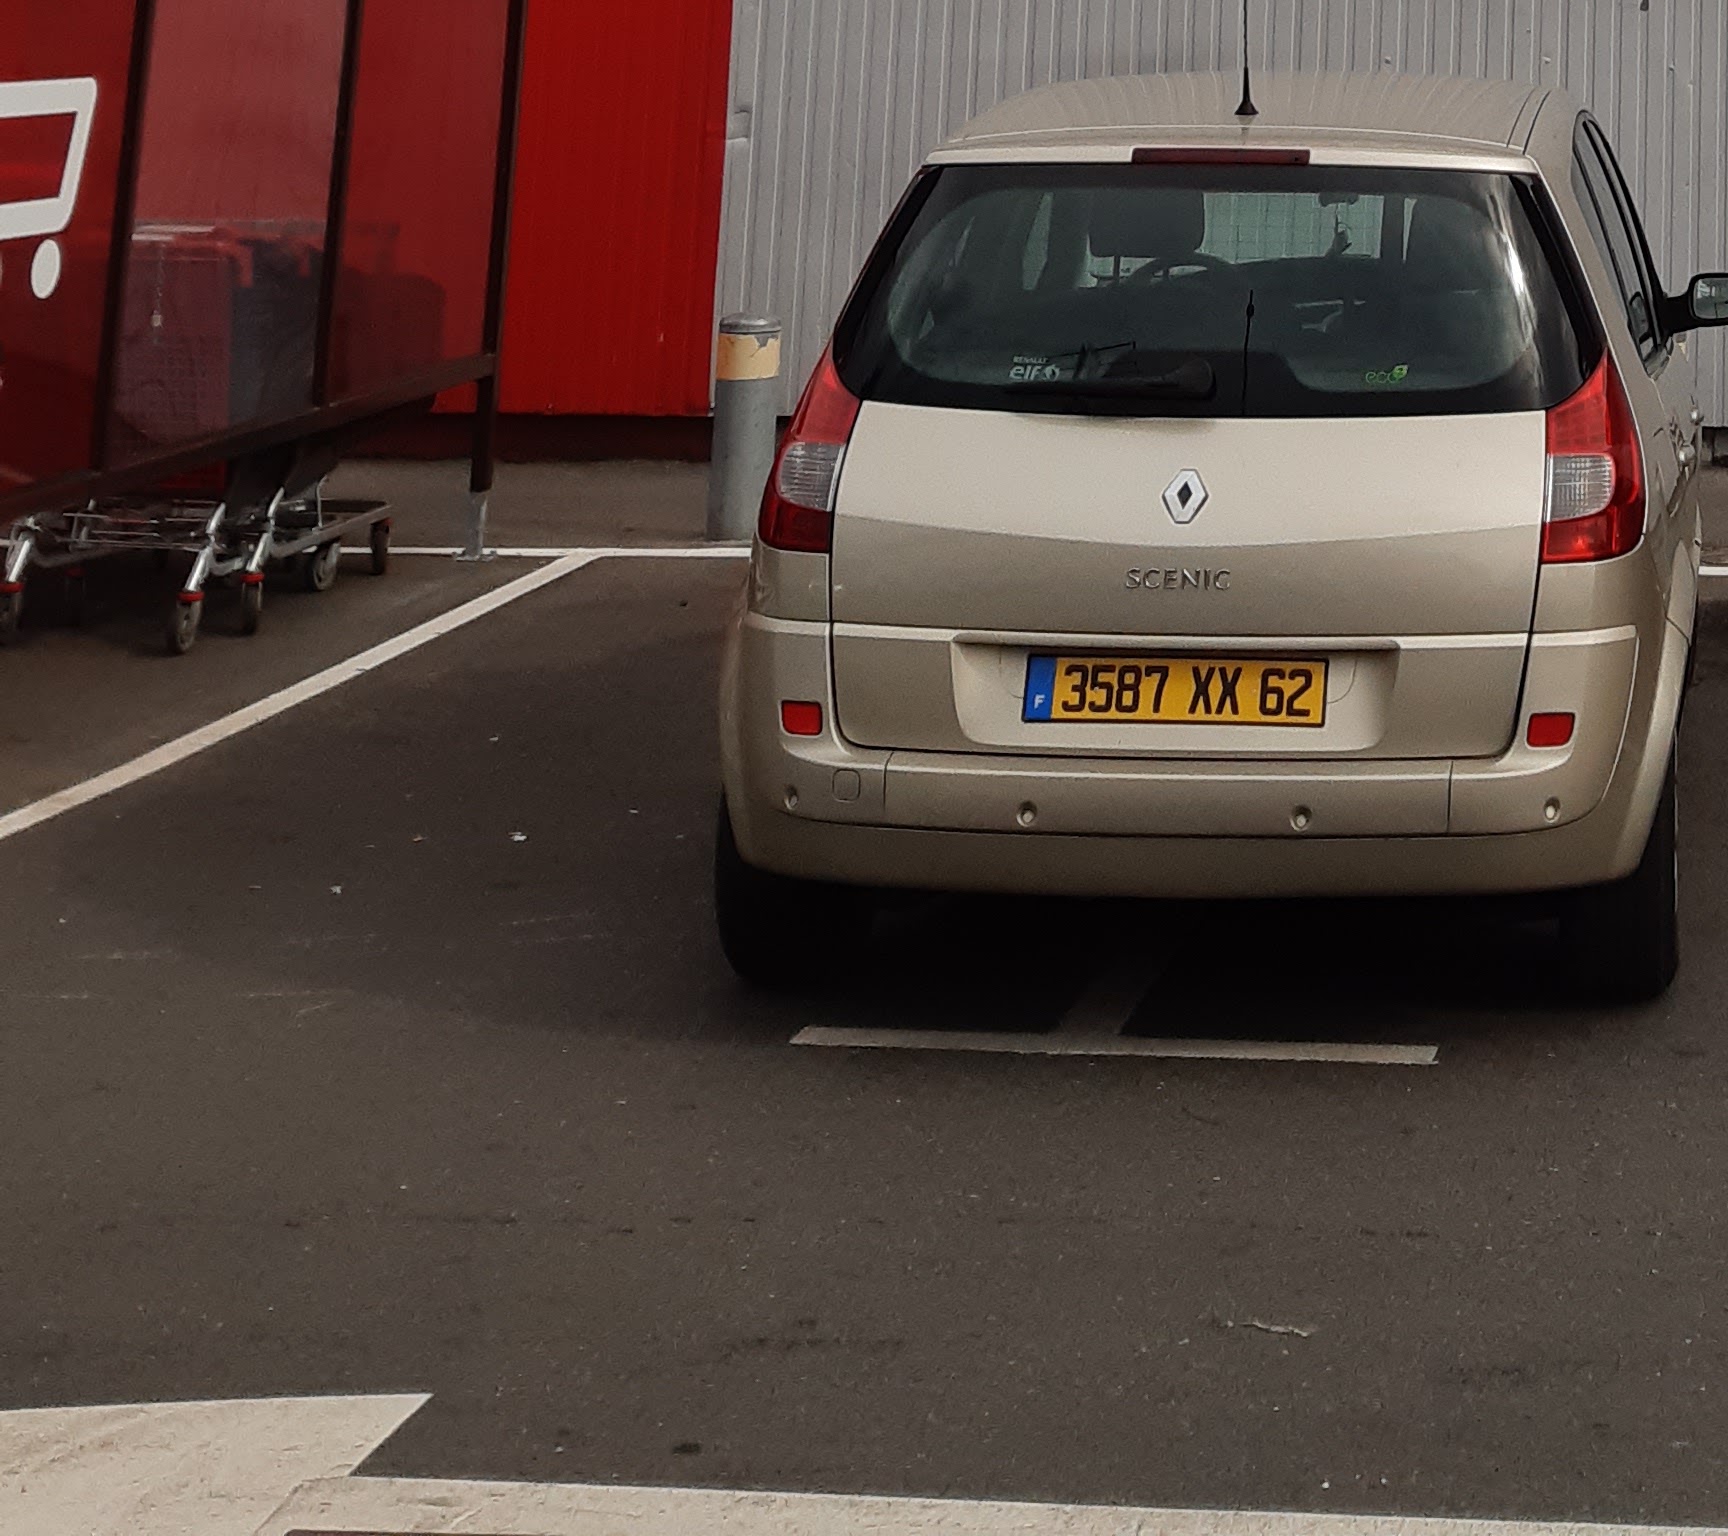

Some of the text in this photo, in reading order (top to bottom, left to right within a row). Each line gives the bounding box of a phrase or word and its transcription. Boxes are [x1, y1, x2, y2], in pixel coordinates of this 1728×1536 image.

[1126, 568, 1231, 589] SCENIC
[1061, 664, 1314, 716] 3587 XX 62
[1034, 694, 1046, 708] F
